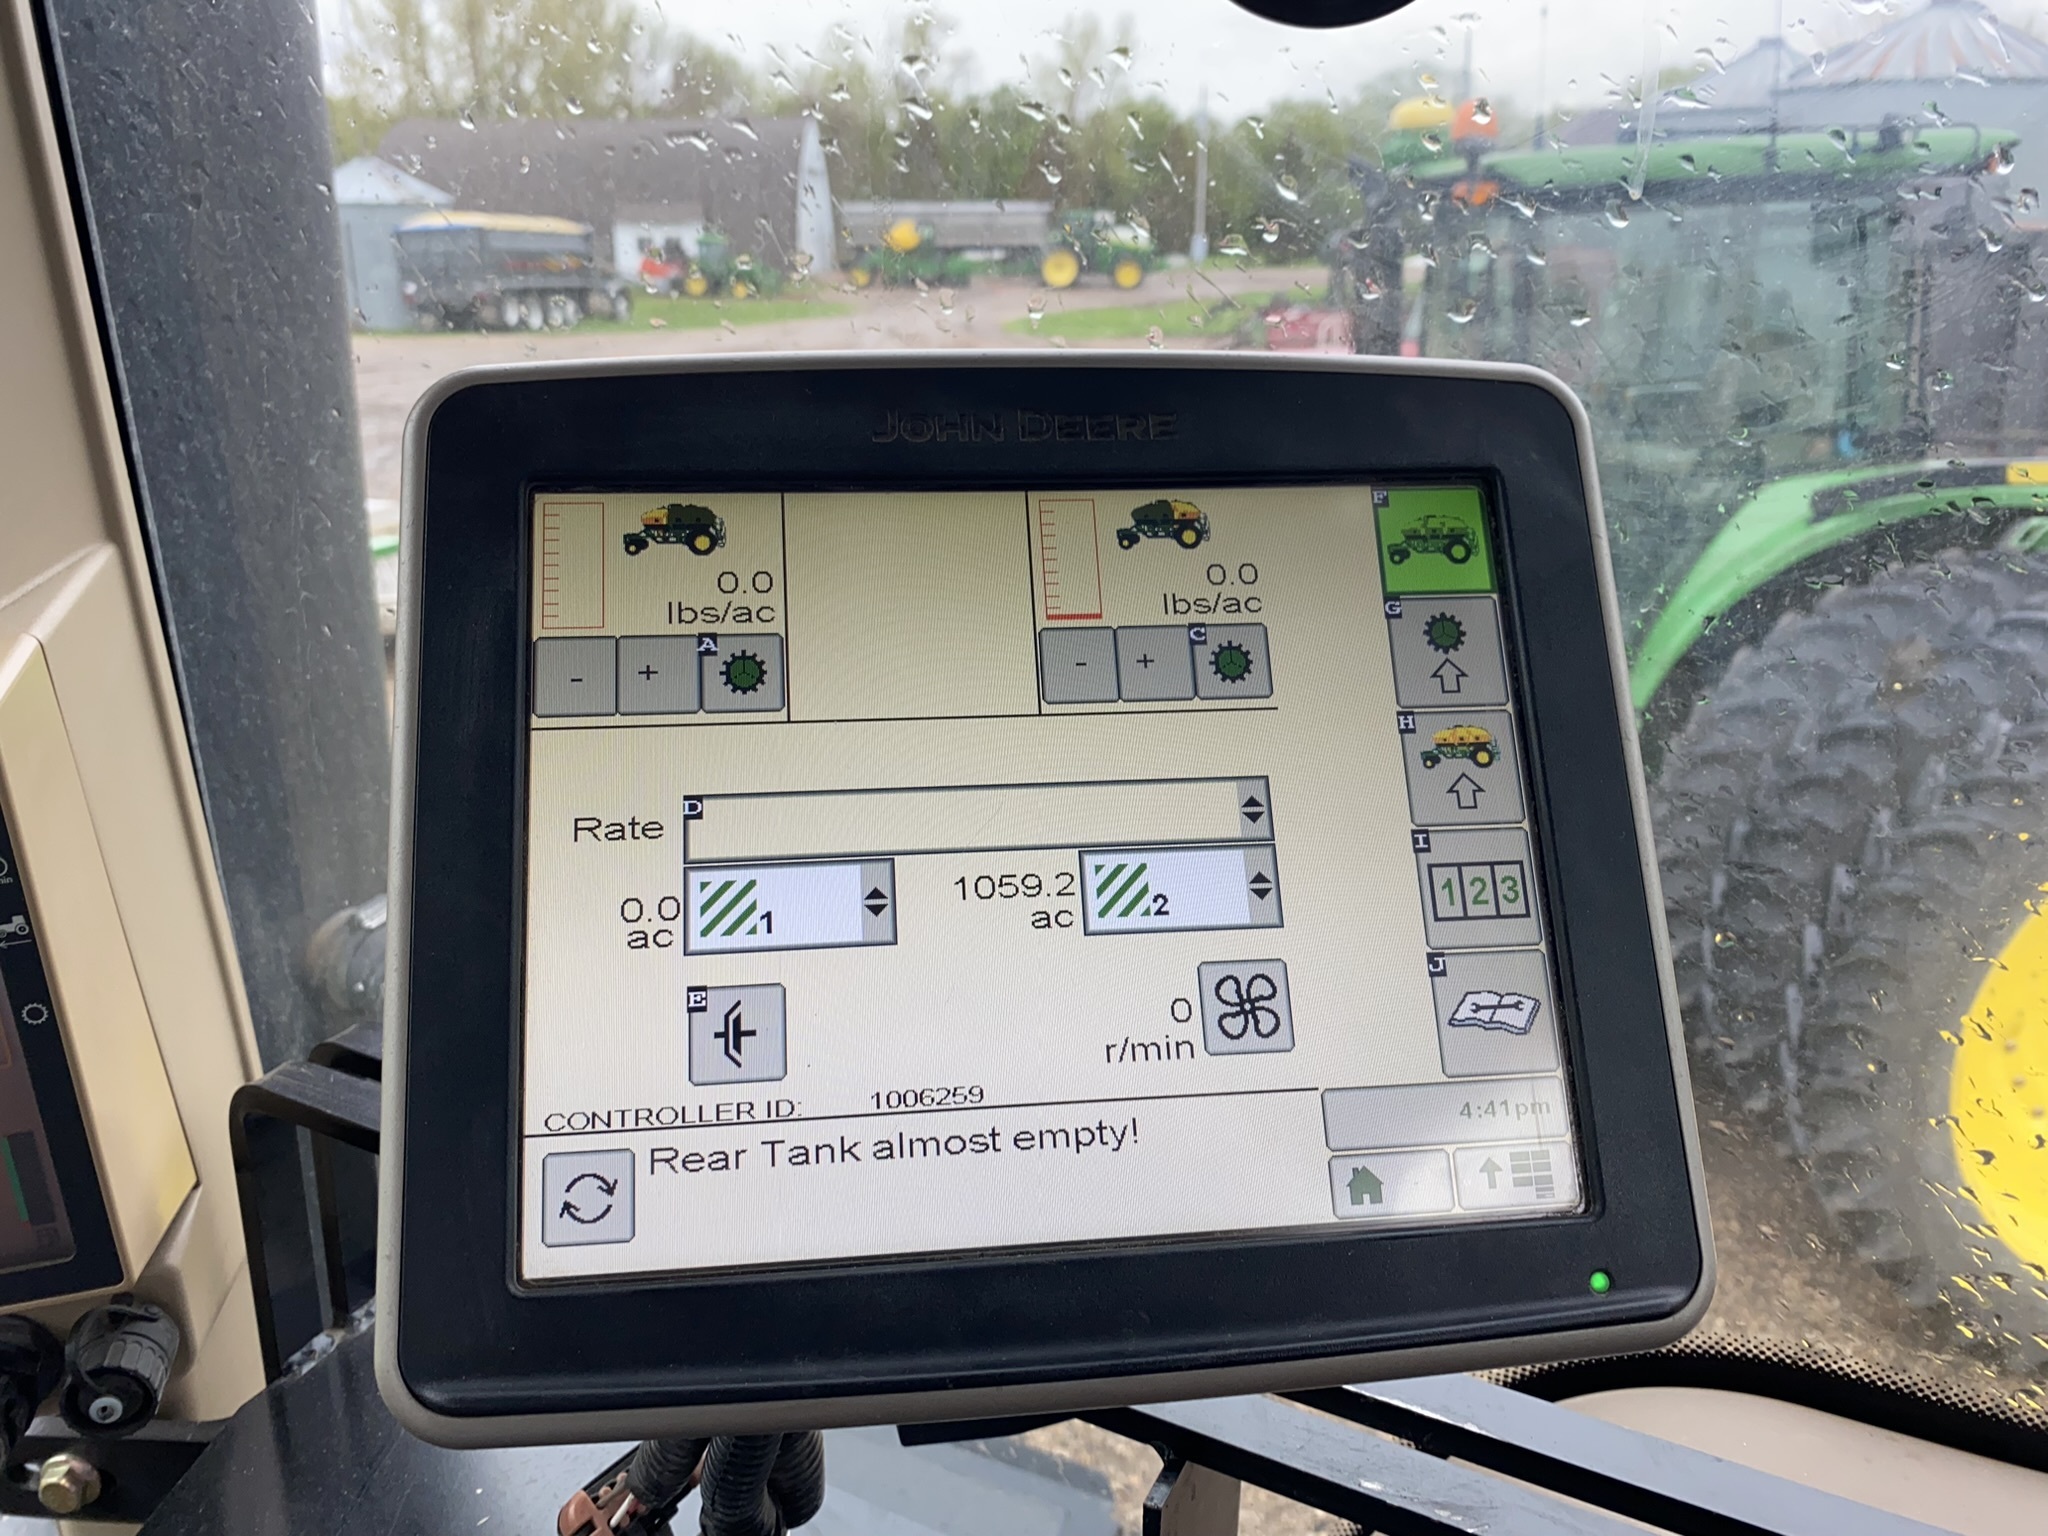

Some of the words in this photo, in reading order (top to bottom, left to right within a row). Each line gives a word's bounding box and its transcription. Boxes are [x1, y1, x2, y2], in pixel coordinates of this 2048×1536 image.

[872, 410, 1004, 443] JOHN
[1018, 410, 1178, 441] DEERE
[1373, 490, 1387, 504] F
[717, 571, 773, 594] 0.0
[1206, 563, 1259, 585] 0.0
[667, 600, 776, 625] lbs/ac
[1162, 592, 1263, 615] lbs/ac
[1385, 601, 1401, 615] G
[697, 635, 718, 651] A
[1189, 627, 1206, 642] C
[1398, 715, 1416, 730] H
[683, 800, 702, 815] D
[574, 816, 665, 843] Rate
[1413, 833, 1429, 848] I
[954, 872, 1076, 901] 1059.2
[620, 896, 681, 923] 0.0
[1152, 893, 1170, 916] 2
[759, 911, 773, 935] 1
[1031, 909, 1075, 930] ac
[627, 929, 675, 949] ac
[1428, 957, 1446, 972] J
[688, 991, 706, 1007] E
[1171, 998, 1192, 1023] 0
[1105, 1035, 1195, 1063] r/min
[870, 1085, 985, 1111] 1006259
[544, 1101, 755, 1133] CONTROLLER
[766, 1098, 803, 1119] ID:
[650, 1147, 748, 1176] Rear
[761, 1135, 862, 1167] Tank
[872, 1126, 1002, 1161] almost
[1013, 1117, 1139, 1155] empty!
